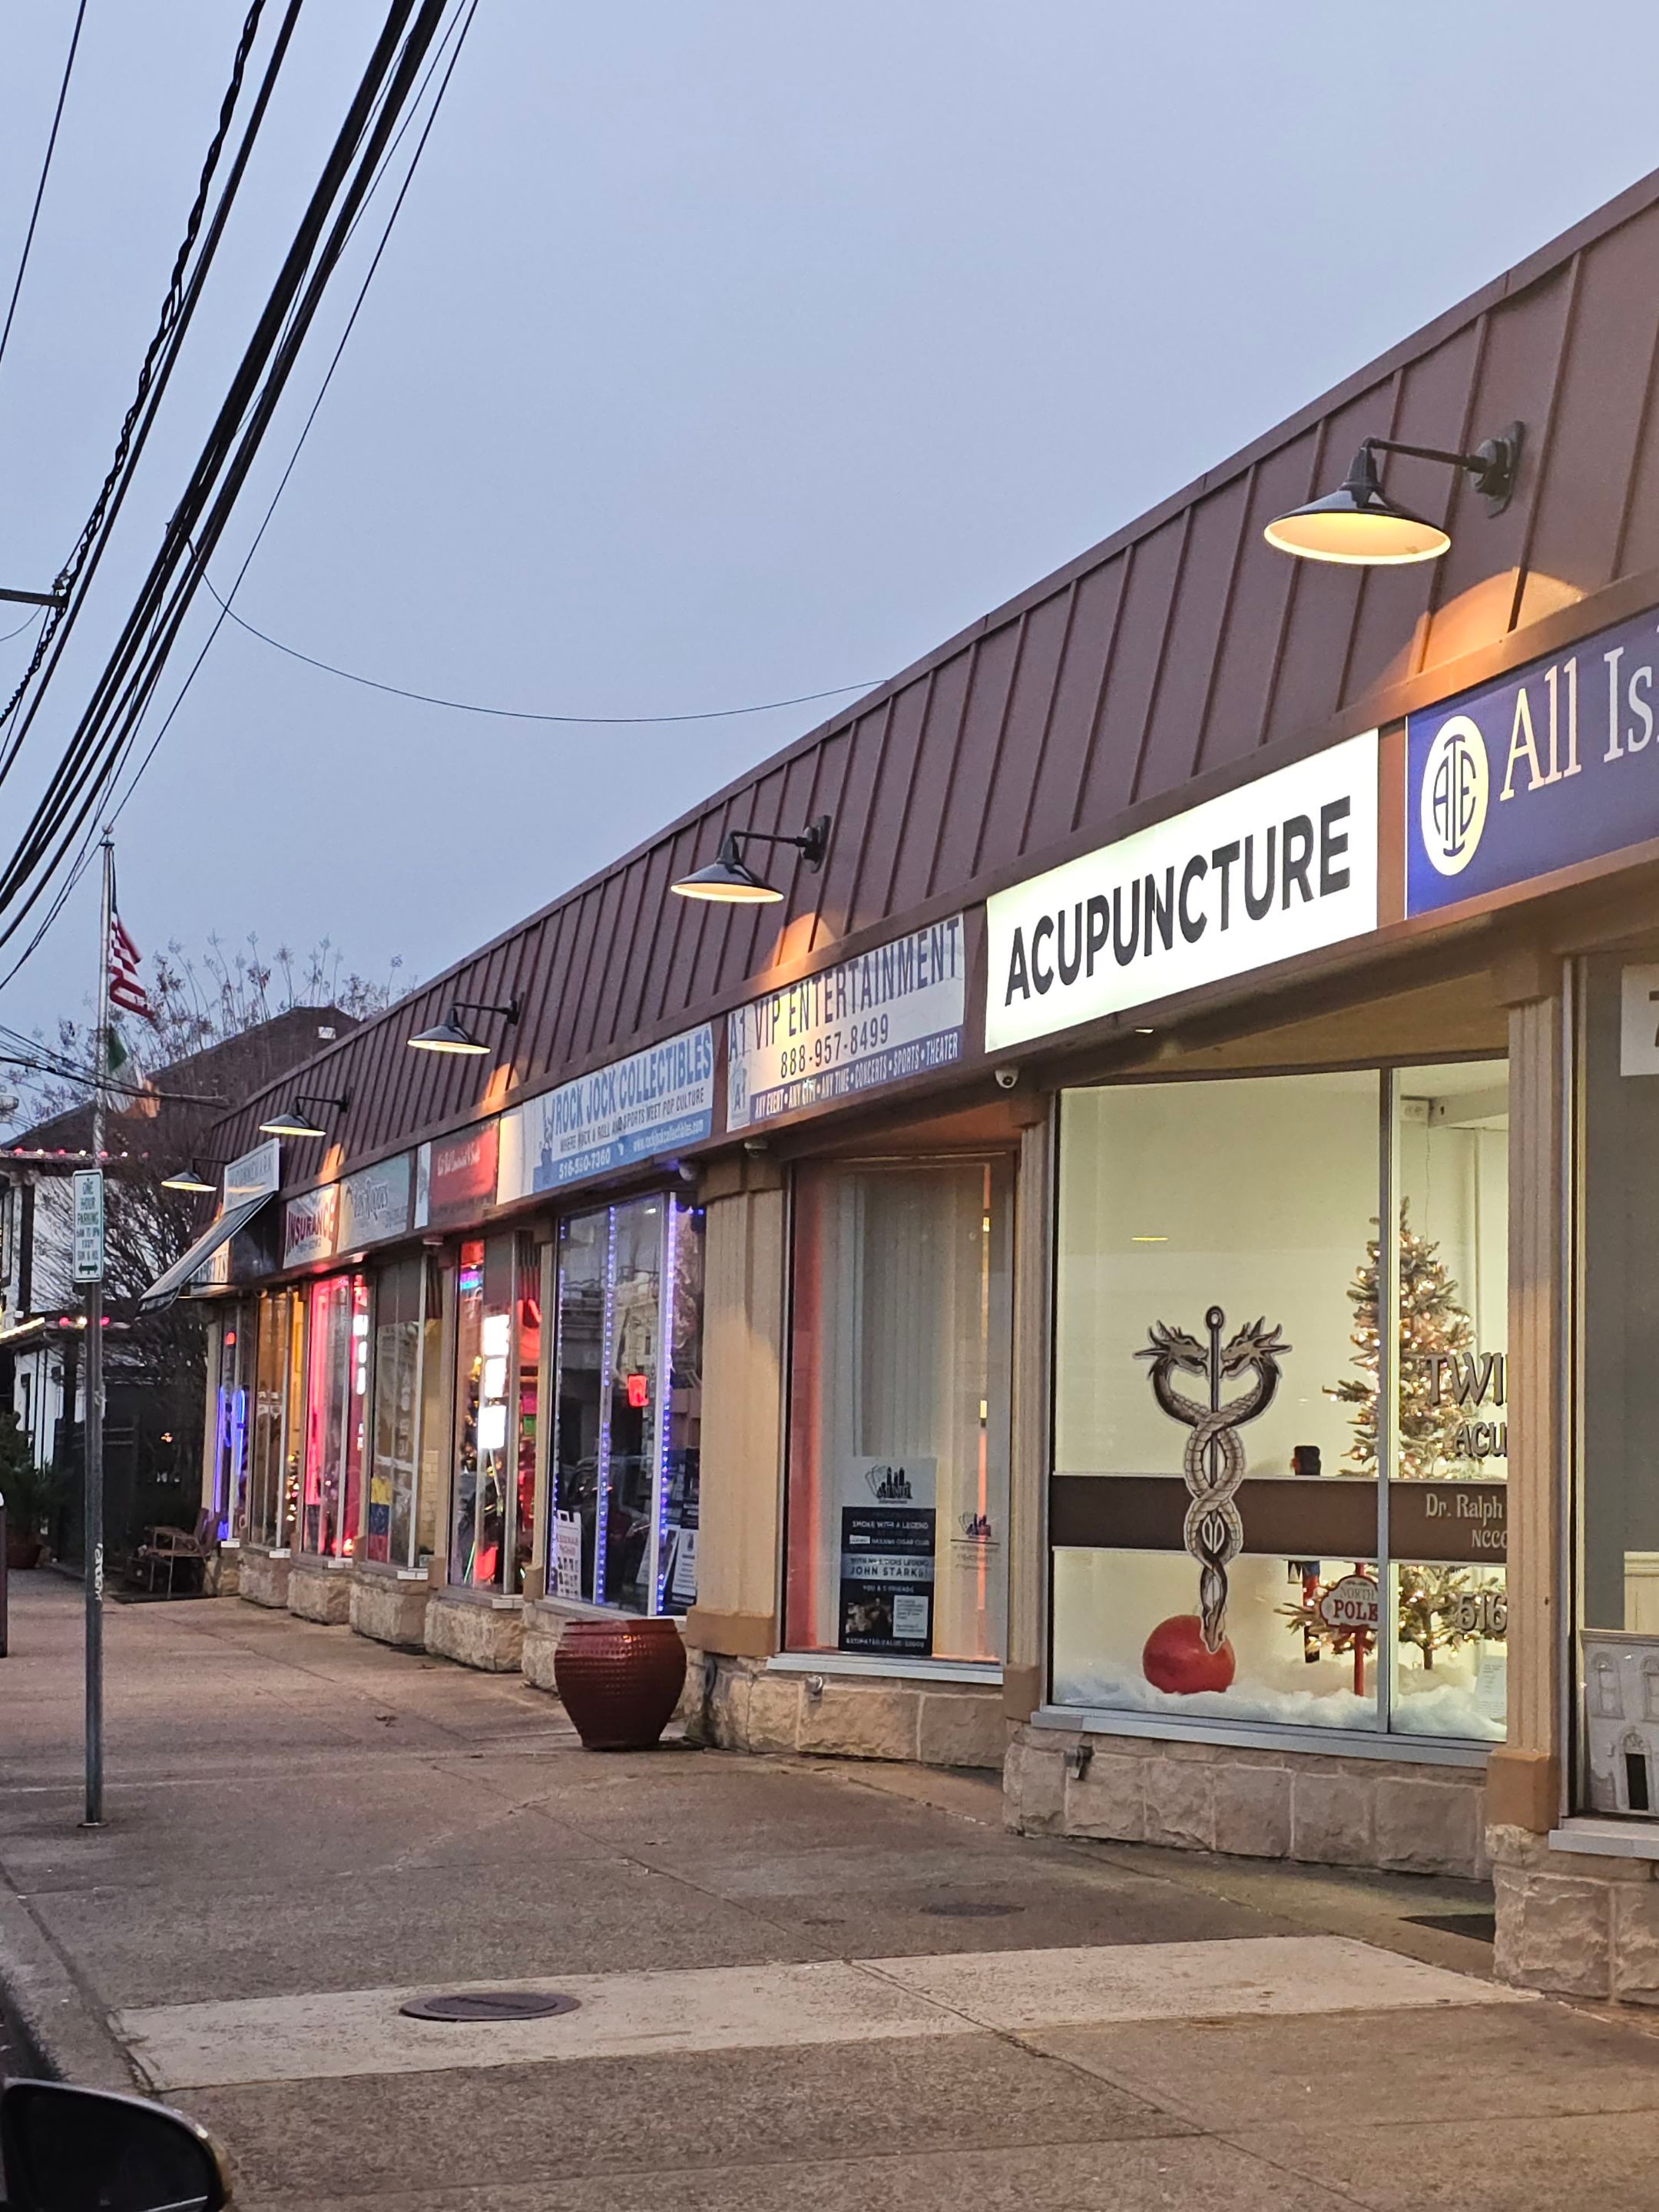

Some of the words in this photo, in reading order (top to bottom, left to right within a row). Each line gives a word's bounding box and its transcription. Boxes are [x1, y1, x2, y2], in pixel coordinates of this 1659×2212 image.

[1500, 657, 1582, 802] All
[1603, 624, 1659, 763] Is
[1005, 795, 1351, 1006] ACUPUNCTURE
[728, 1008, 747, 1062] A1
[754, 994, 780, 1050] VIP
[789, 917, 959, 1036] ENTERTAINMENT
[780, 1014, 889, 1078] 888-957-8499
[855, 1055, 887, 1089] CONCERTS
[893, 1044, 920, 1077] SPORTS
[926, 1031, 958, 1066] THEATER
[555, 1084, 584, 1135] ROCK
[587, 1069, 616, 1124] JOCK
[619, 1029, 711, 1109] COLLECTIBLES
[623, 1109, 645, 1131] SPORTS
[663, 1099, 674, 1117] POP
[676, 1088, 704, 1112] CULTURE
[78, 1212, 98, 1225] PARKING
[286, 1198, 336, 1257] INSURANCE
[1423, 1352, 1508, 1406] TWI
[852, 1520, 875, 1528] SMOKE
[902, 1522, 929, 1530] LEGEND
[1426, 1493, 1452, 1517] Dr.
[1456, 1494, 1503, 1527] Ralph
[850, 1566, 878, 1575] JOHN
[1339, 1586, 1376, 1601] NORTH
[1334, 1599, 1378, 1622] POLE
